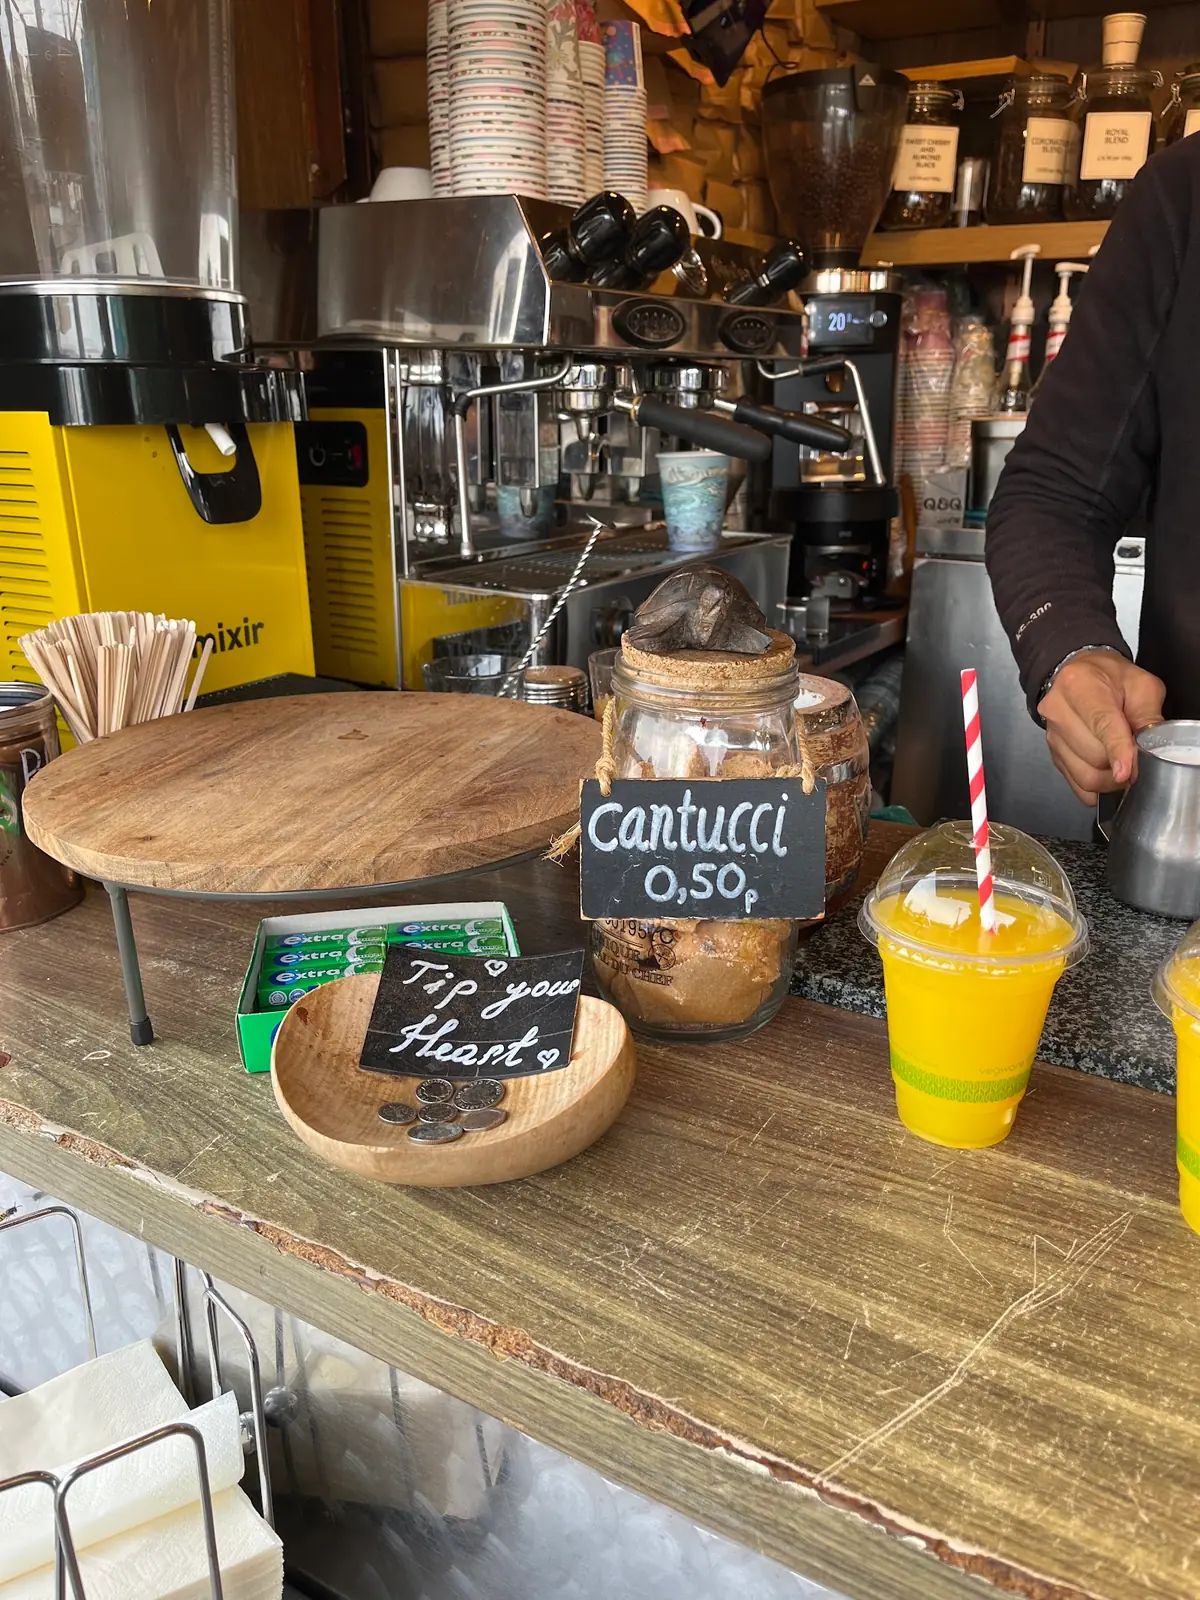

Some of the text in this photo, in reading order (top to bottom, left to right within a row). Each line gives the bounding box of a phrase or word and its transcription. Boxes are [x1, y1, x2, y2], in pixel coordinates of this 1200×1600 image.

[403, 922, 462, 933] extra
[283, 933, 344, 945] extra
[280, 950, 343, 963] extra
[275, 968, 341, 981] extra
[402, 960, 478, 1010] Tip
[389, 1013, 539, 1067] Heart
